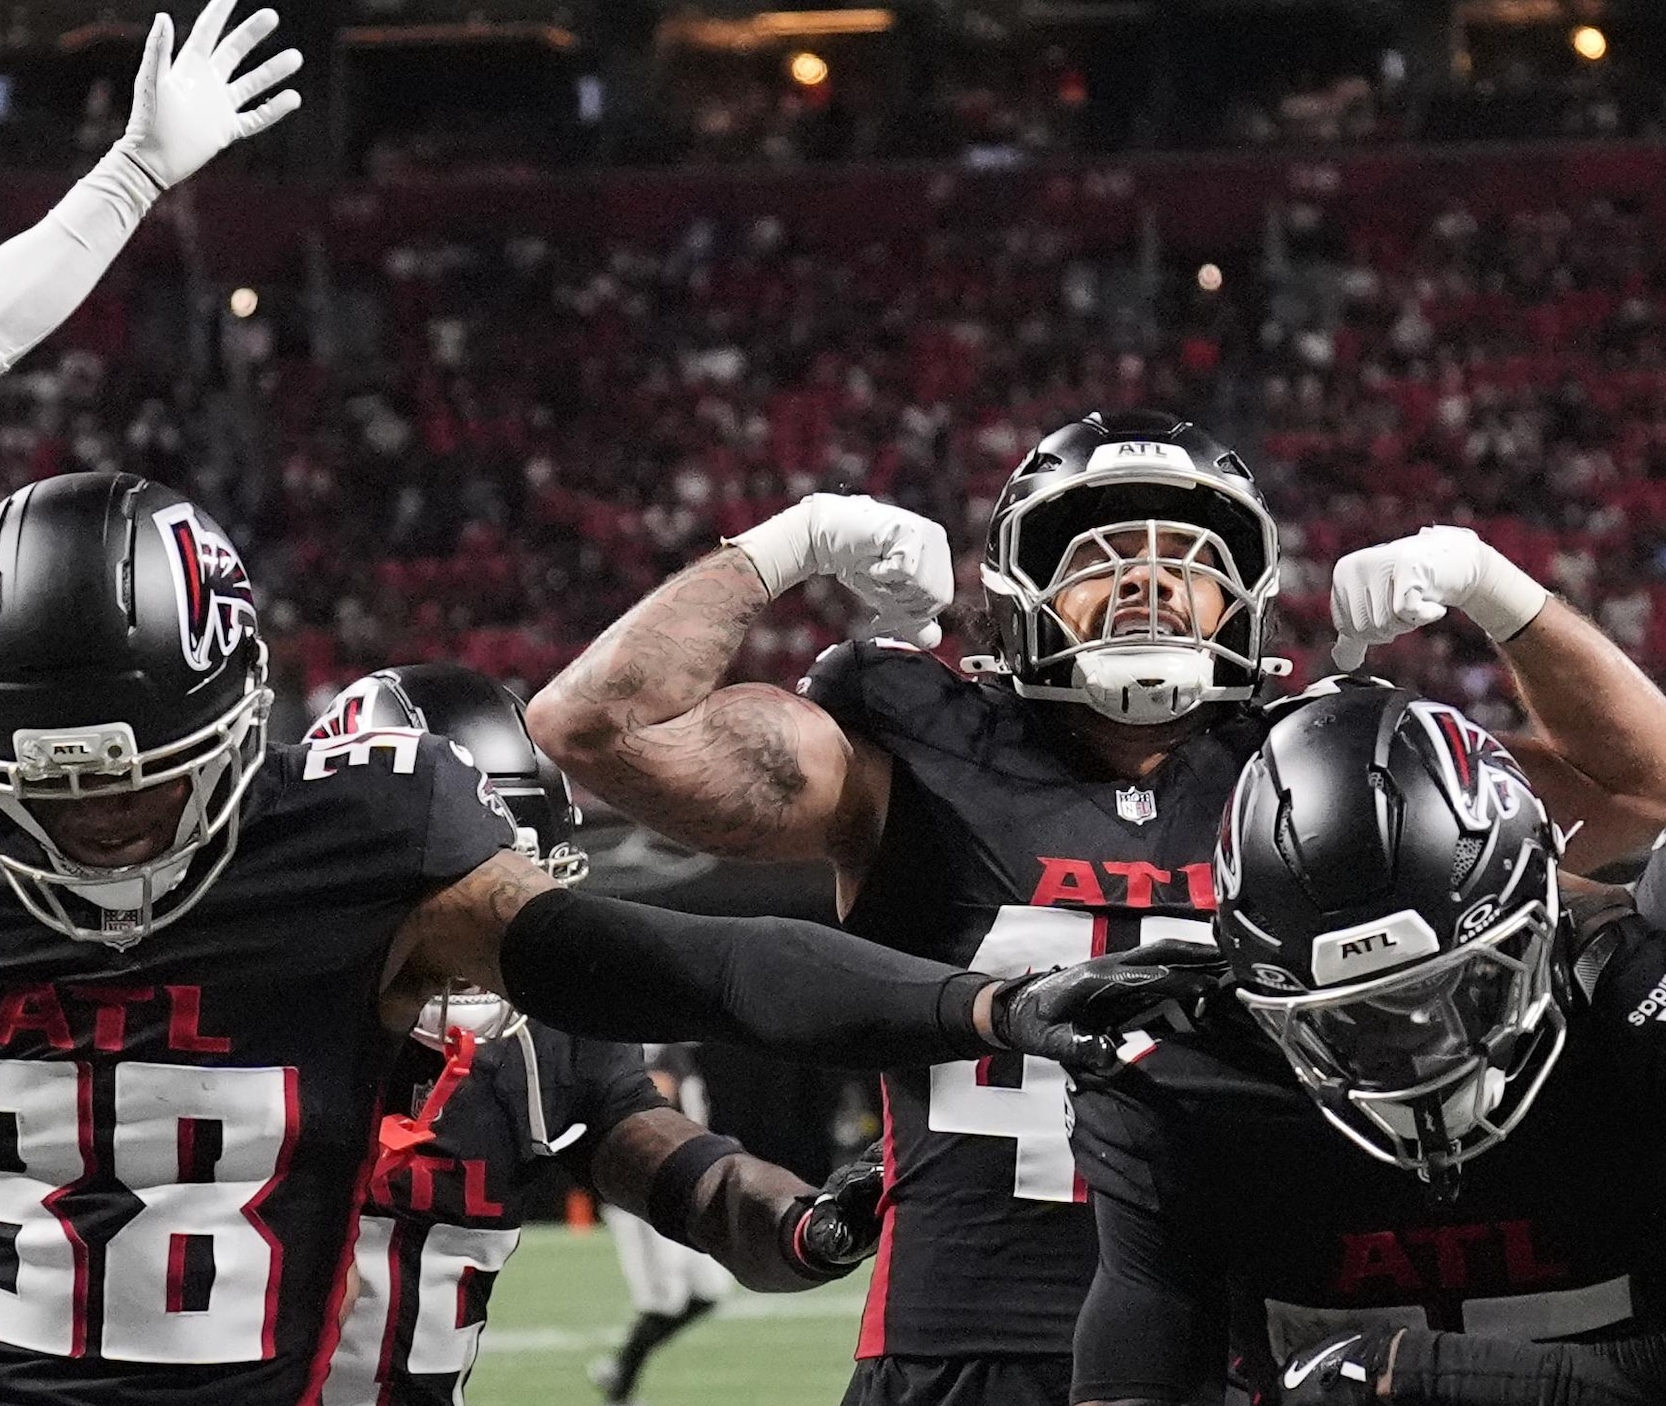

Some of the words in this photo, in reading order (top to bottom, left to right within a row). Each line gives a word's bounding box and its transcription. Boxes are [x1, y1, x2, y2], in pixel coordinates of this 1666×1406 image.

[1119, 442, 1168, 457] ATL
[52, 743, 90, 756] ATL
[1340, 932, 1398, 960] ATL
[1333, 1218, 1569, 1294] ATL
